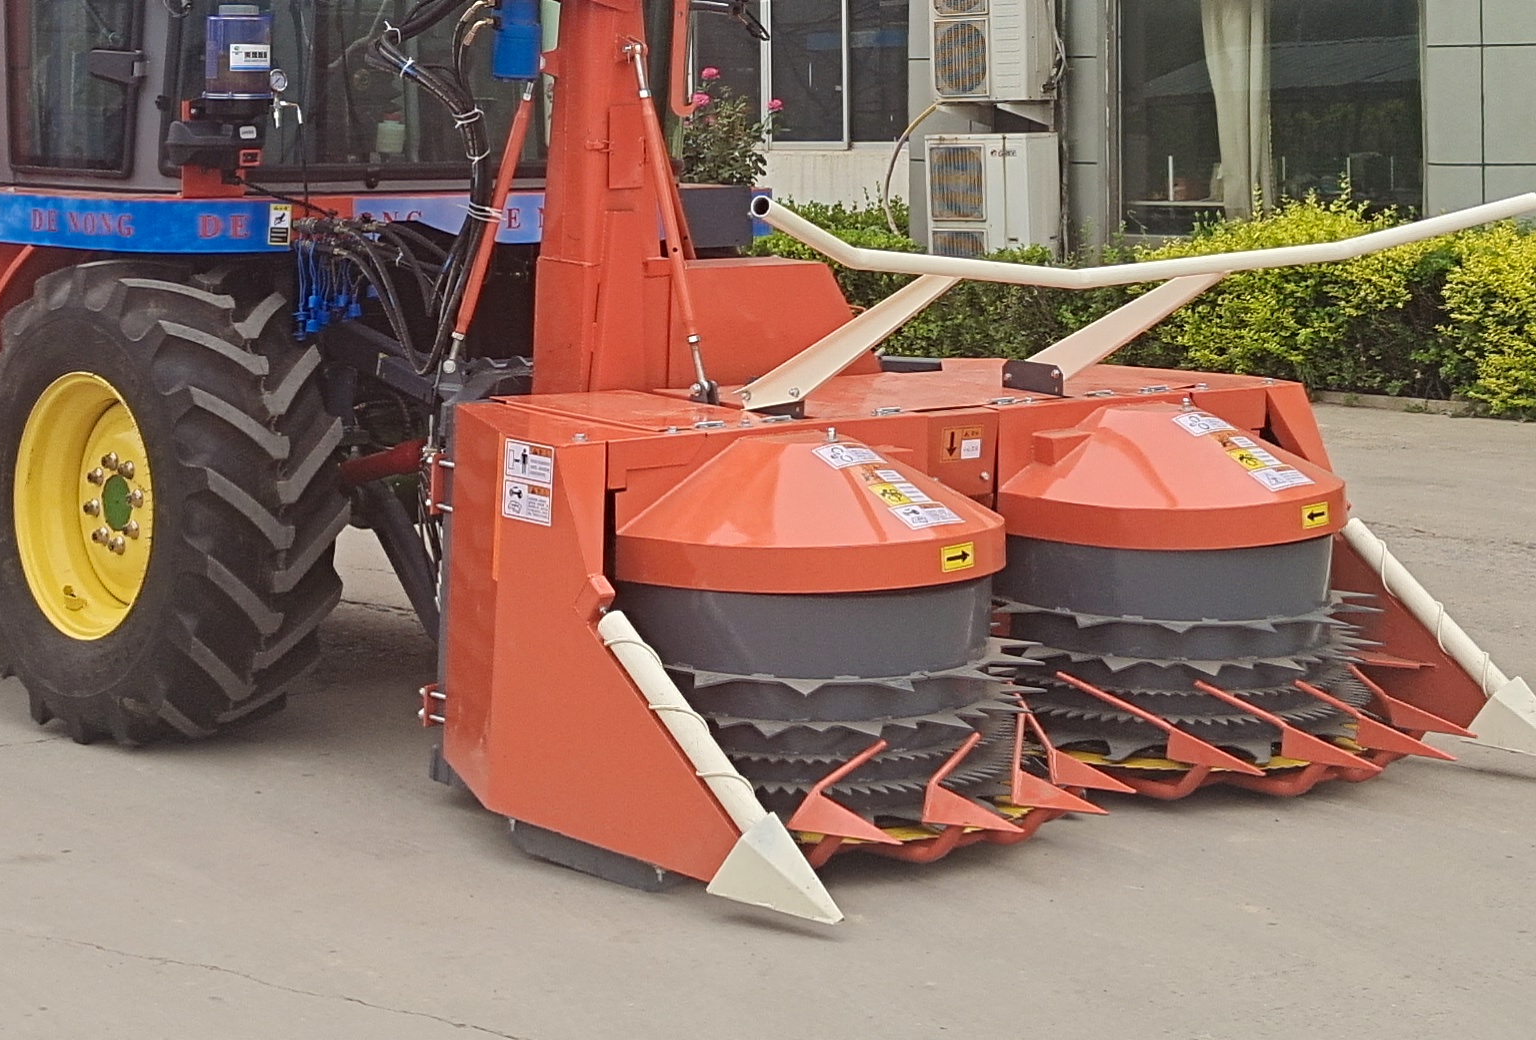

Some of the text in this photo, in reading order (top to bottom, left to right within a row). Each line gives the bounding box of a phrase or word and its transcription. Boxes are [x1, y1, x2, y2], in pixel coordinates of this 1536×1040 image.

[30, 209, 134, 237] DE NONG
[199, 214, 250, 238] DE
